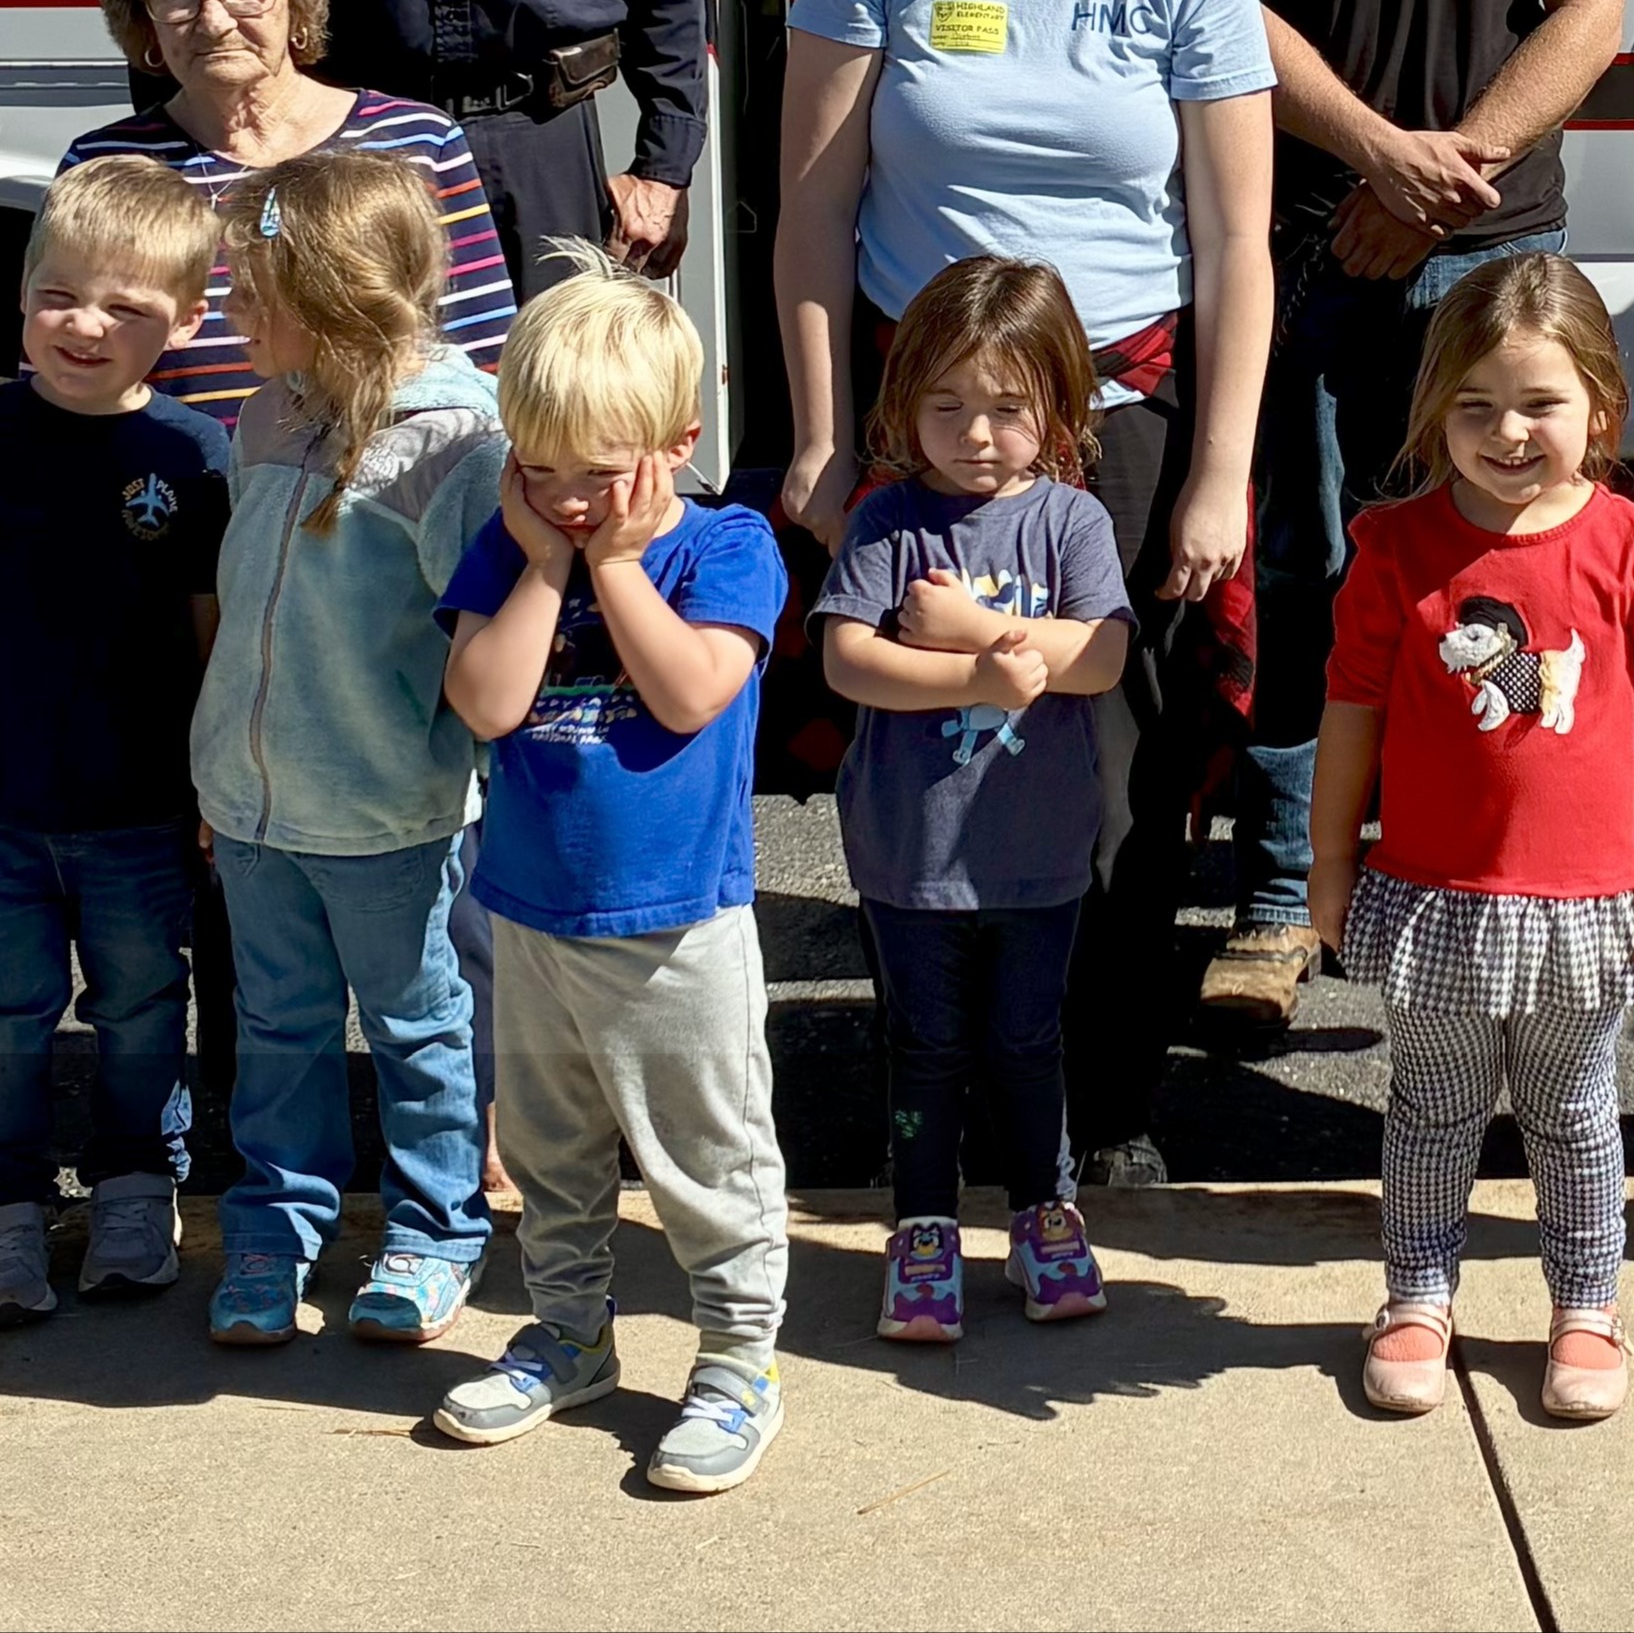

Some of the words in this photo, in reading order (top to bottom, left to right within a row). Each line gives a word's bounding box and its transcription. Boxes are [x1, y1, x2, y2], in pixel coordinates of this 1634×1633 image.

[956, 2, 1005, 14] HIGHLAND
[1071, 2, 1154, 35] HMC
[936, 24, 974, 32] VISITOR
[976, 26, 999, 35] PASS
[156, 480, 178, 513] PLANE
